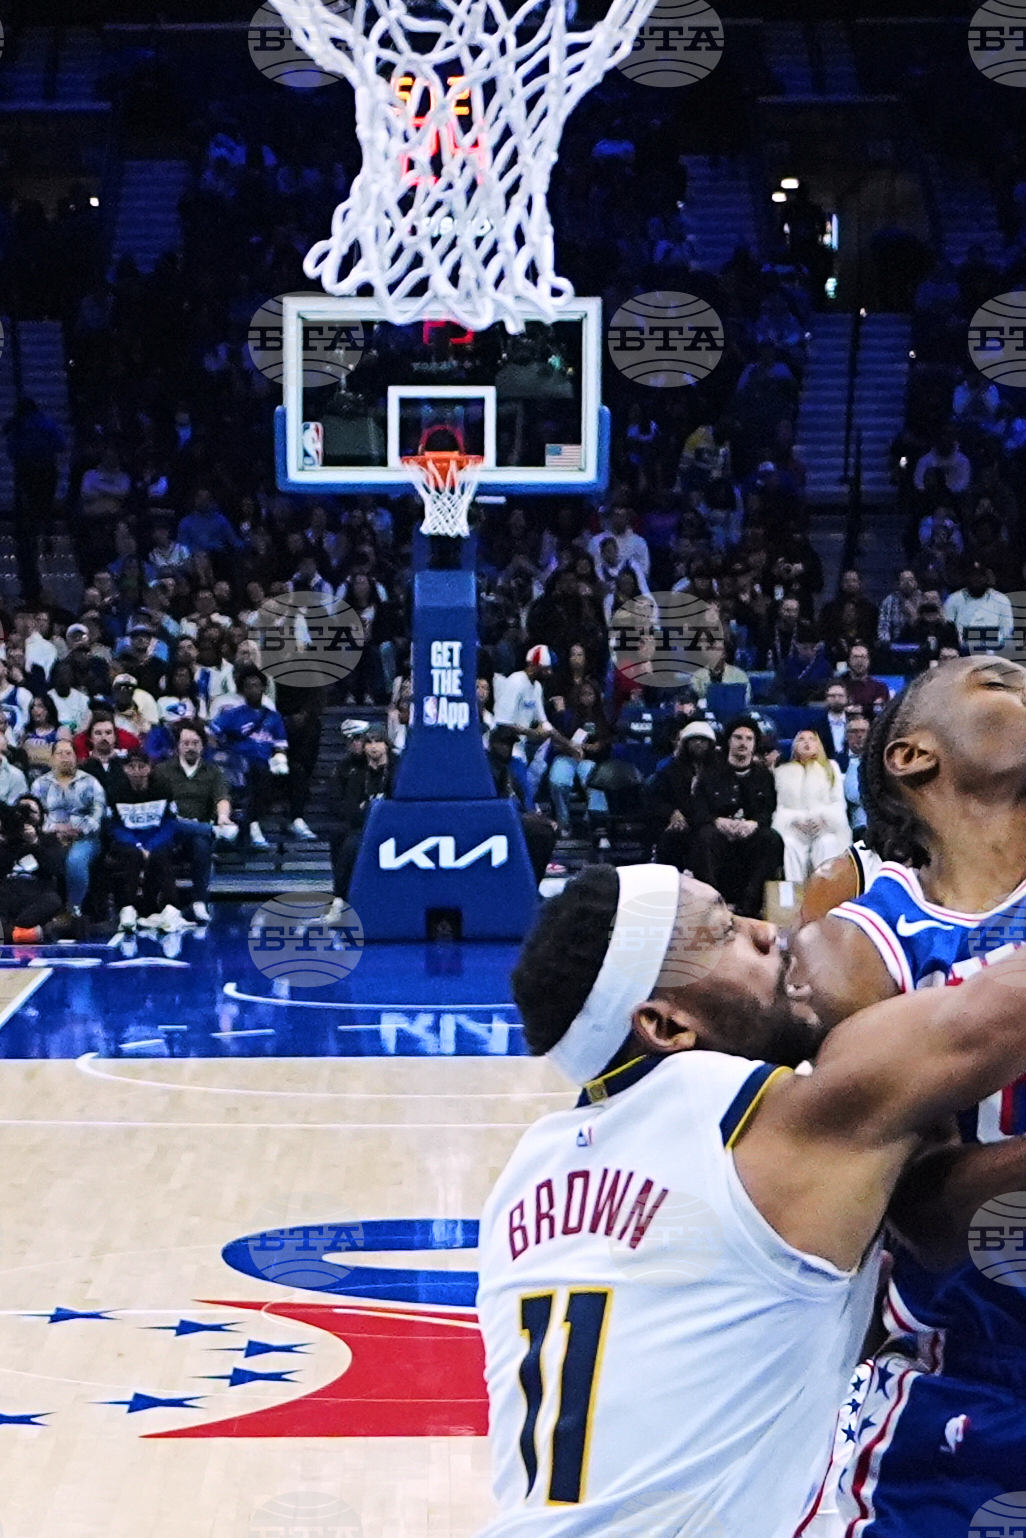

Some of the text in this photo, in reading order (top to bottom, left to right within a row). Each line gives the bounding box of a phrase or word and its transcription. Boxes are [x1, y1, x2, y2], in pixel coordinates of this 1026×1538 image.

[430, 640, 463, 668] GET
[431, 669, 463, 697] THE
[437, 698, 470, 731] App
[378, 834, 509, 870] KIA
[507, 1167, 670, 1262] BROWN
[517, 1286, 615, 1507] 11
